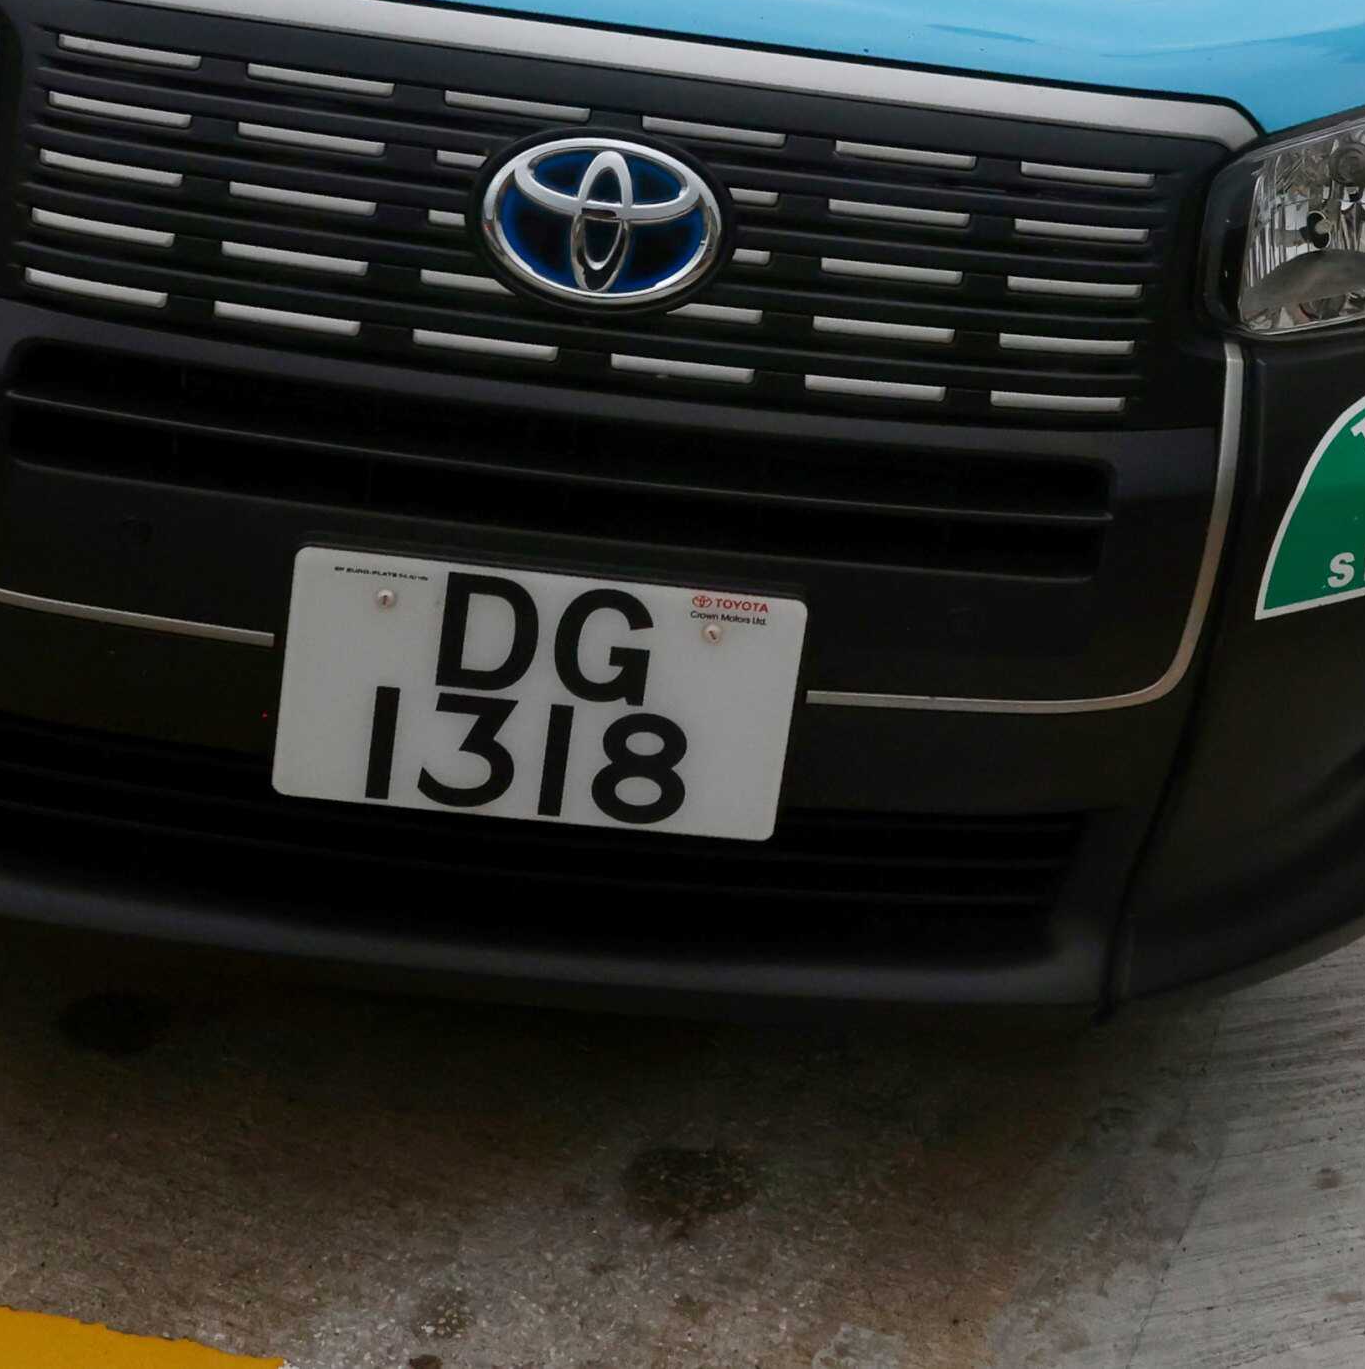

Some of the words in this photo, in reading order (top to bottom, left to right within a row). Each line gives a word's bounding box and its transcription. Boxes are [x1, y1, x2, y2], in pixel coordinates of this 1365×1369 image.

[435, 571, 654, 706] DG
[690, 610, 718, 620] Crown
[721, 613, 750, 624] Motors
[716, 598, 768, 613] TOYOTA
[364, 685, 688, 825] 1318
